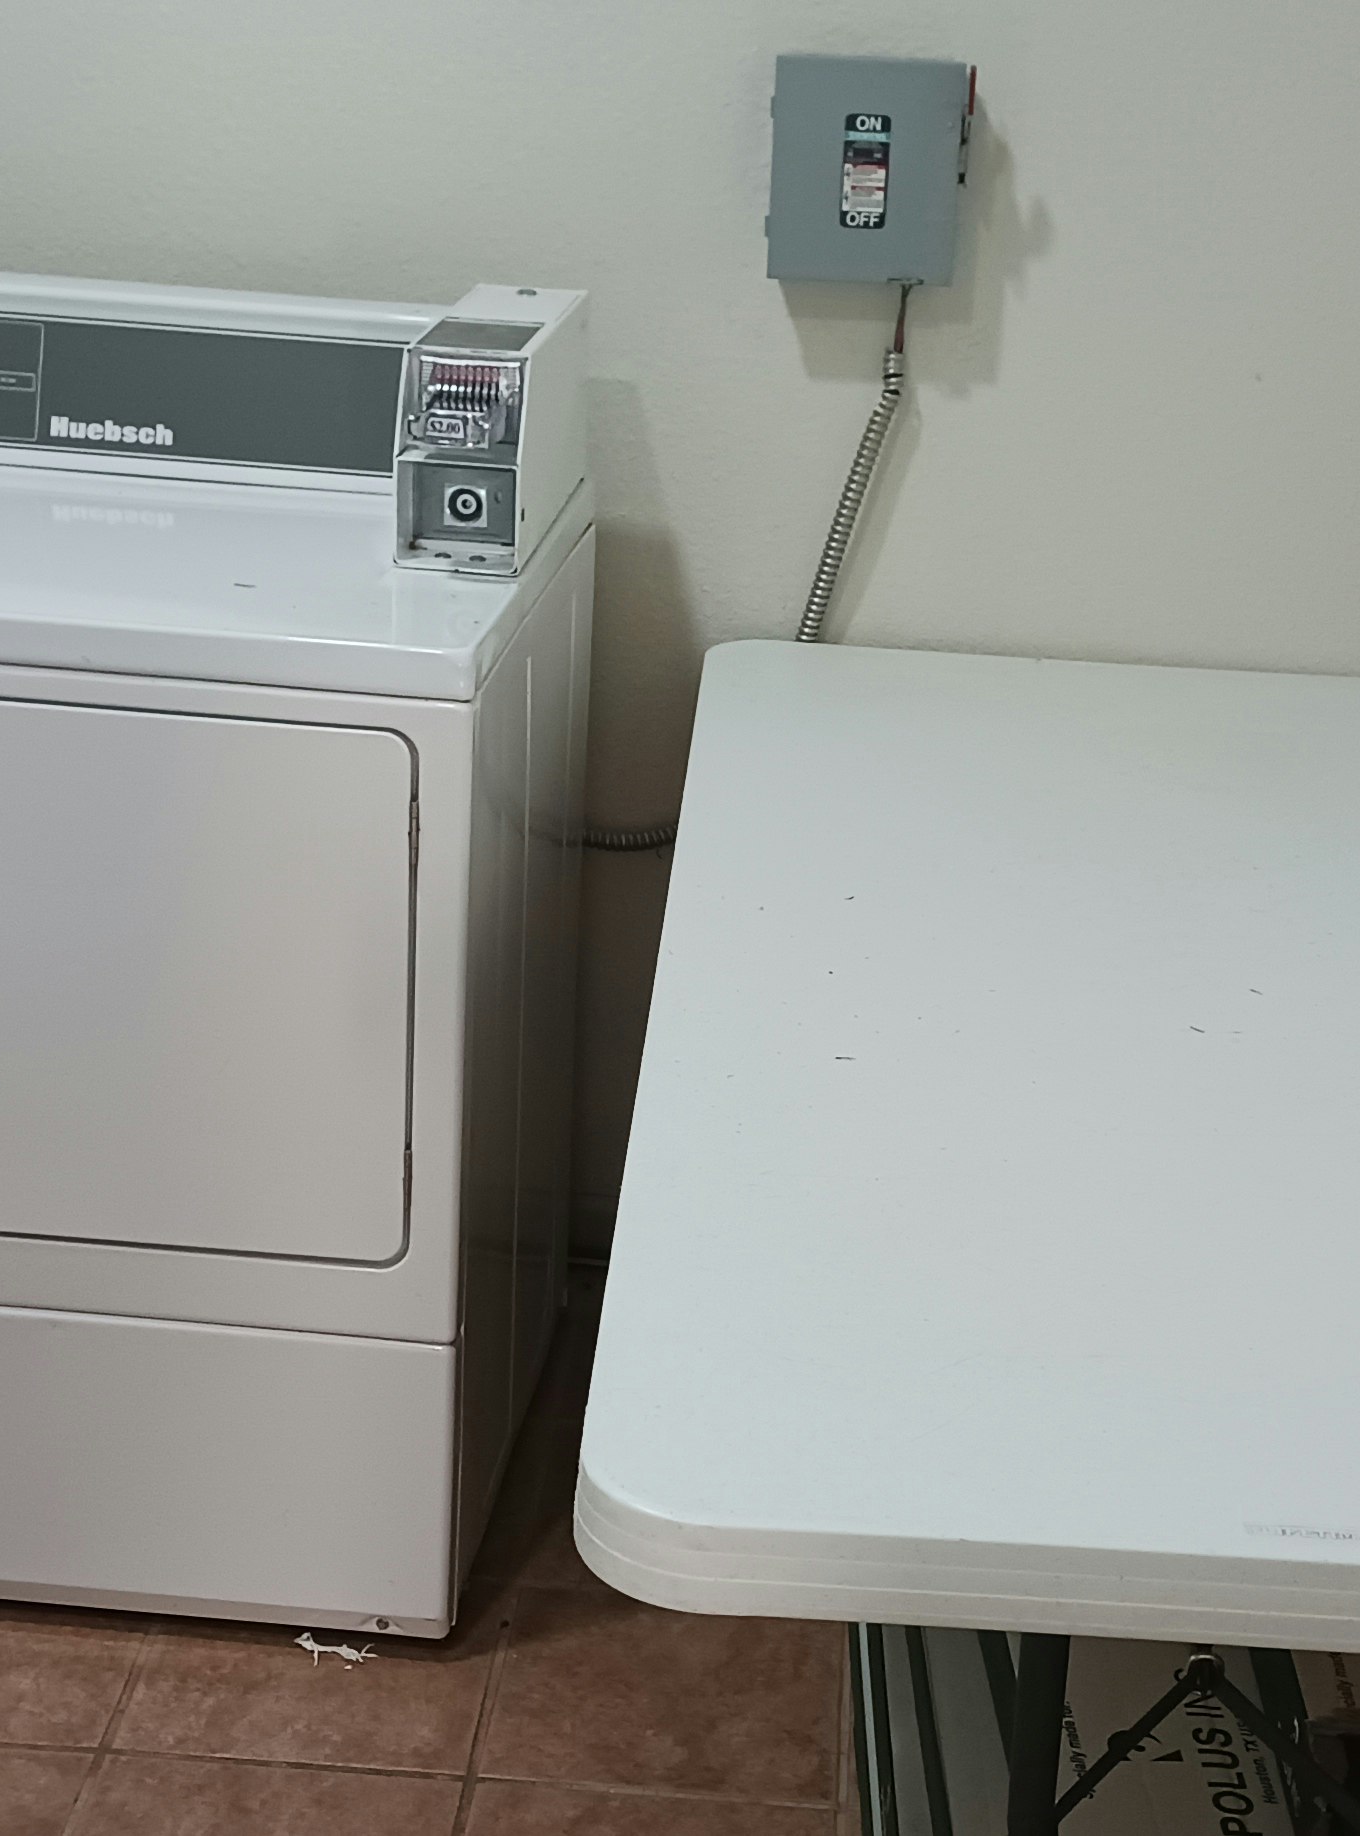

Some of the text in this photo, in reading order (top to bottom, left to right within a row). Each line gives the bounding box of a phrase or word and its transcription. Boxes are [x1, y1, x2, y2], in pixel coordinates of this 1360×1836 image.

[856, 116, 882, 131] ON
[846, 212, 880, 228] OFF
[49, 415, 174, 446] Huebsch
[1242, 1737, 1259, 1752] TX
[1192, 1726, 1264, 1836] POLUS
